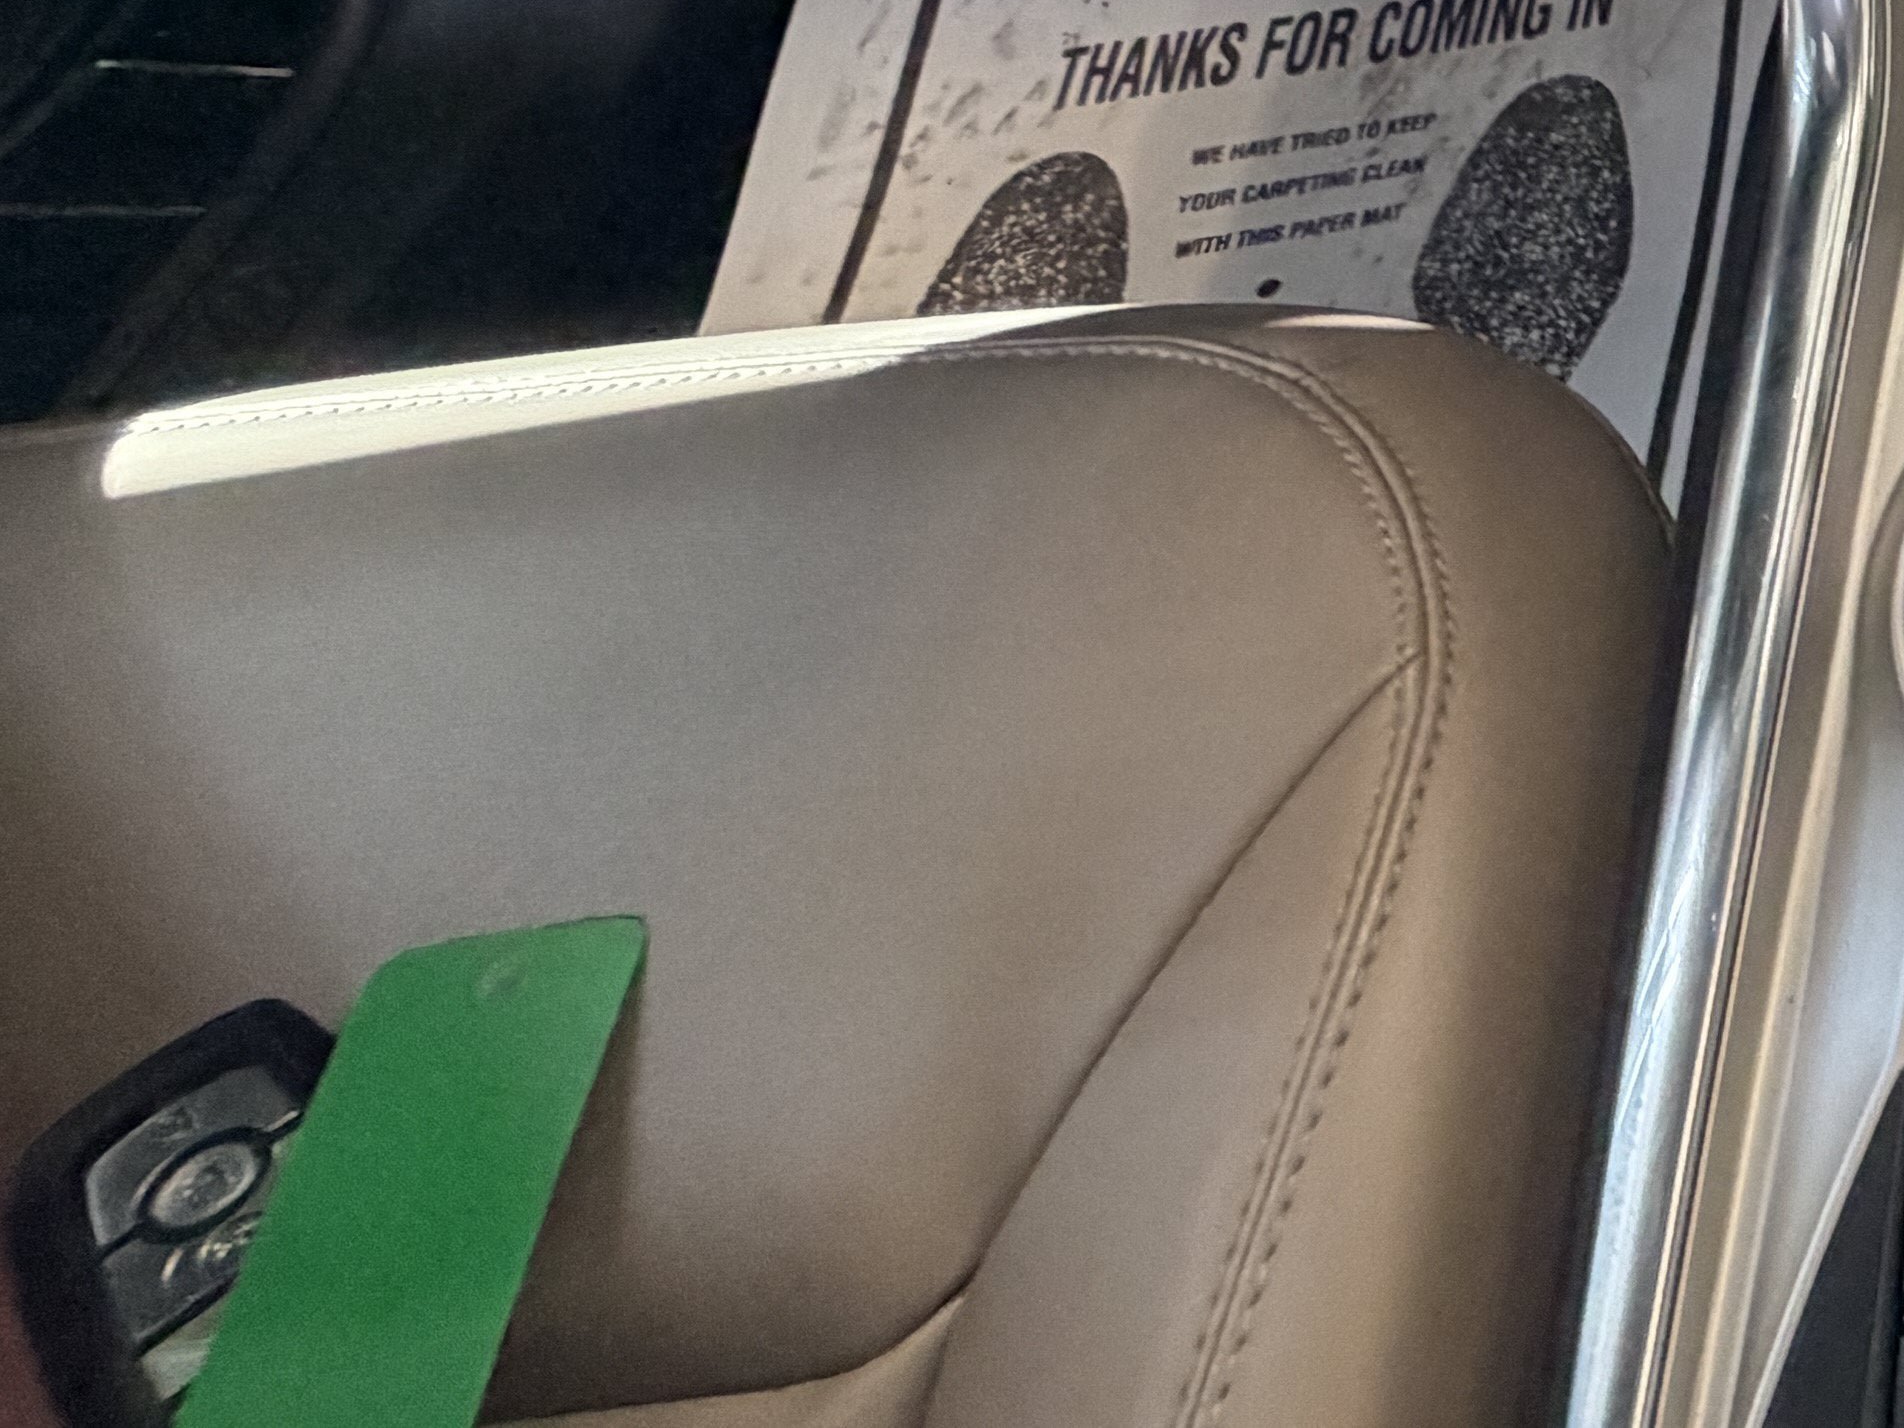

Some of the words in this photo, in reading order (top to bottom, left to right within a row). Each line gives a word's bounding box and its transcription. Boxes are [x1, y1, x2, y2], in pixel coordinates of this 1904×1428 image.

[1053, 21, 1248, 113] THANKS
[1255, 6, 1359, 81] FOR
[1191, 144, 1226, 167] WE
[1229, 135, 1286, 162] HAVE
[1290, 126, 1352, 151] TRIED
[1357, 119, 1382, 141] TO
[1384, 112, 1438, 136] KEEP
[1178, 187, 1238, 214] YOUR
[1240, 166, 1361, 205] CARPETING
[1360, 154, 1430, 185] CLEAN
[1174, 232, 1234, 260] WITH
[1236, 223, 1286, 250] THIS
[1287, 210, 1358, 241] PAPER
[1360, 201, 1408, 228] MAT
